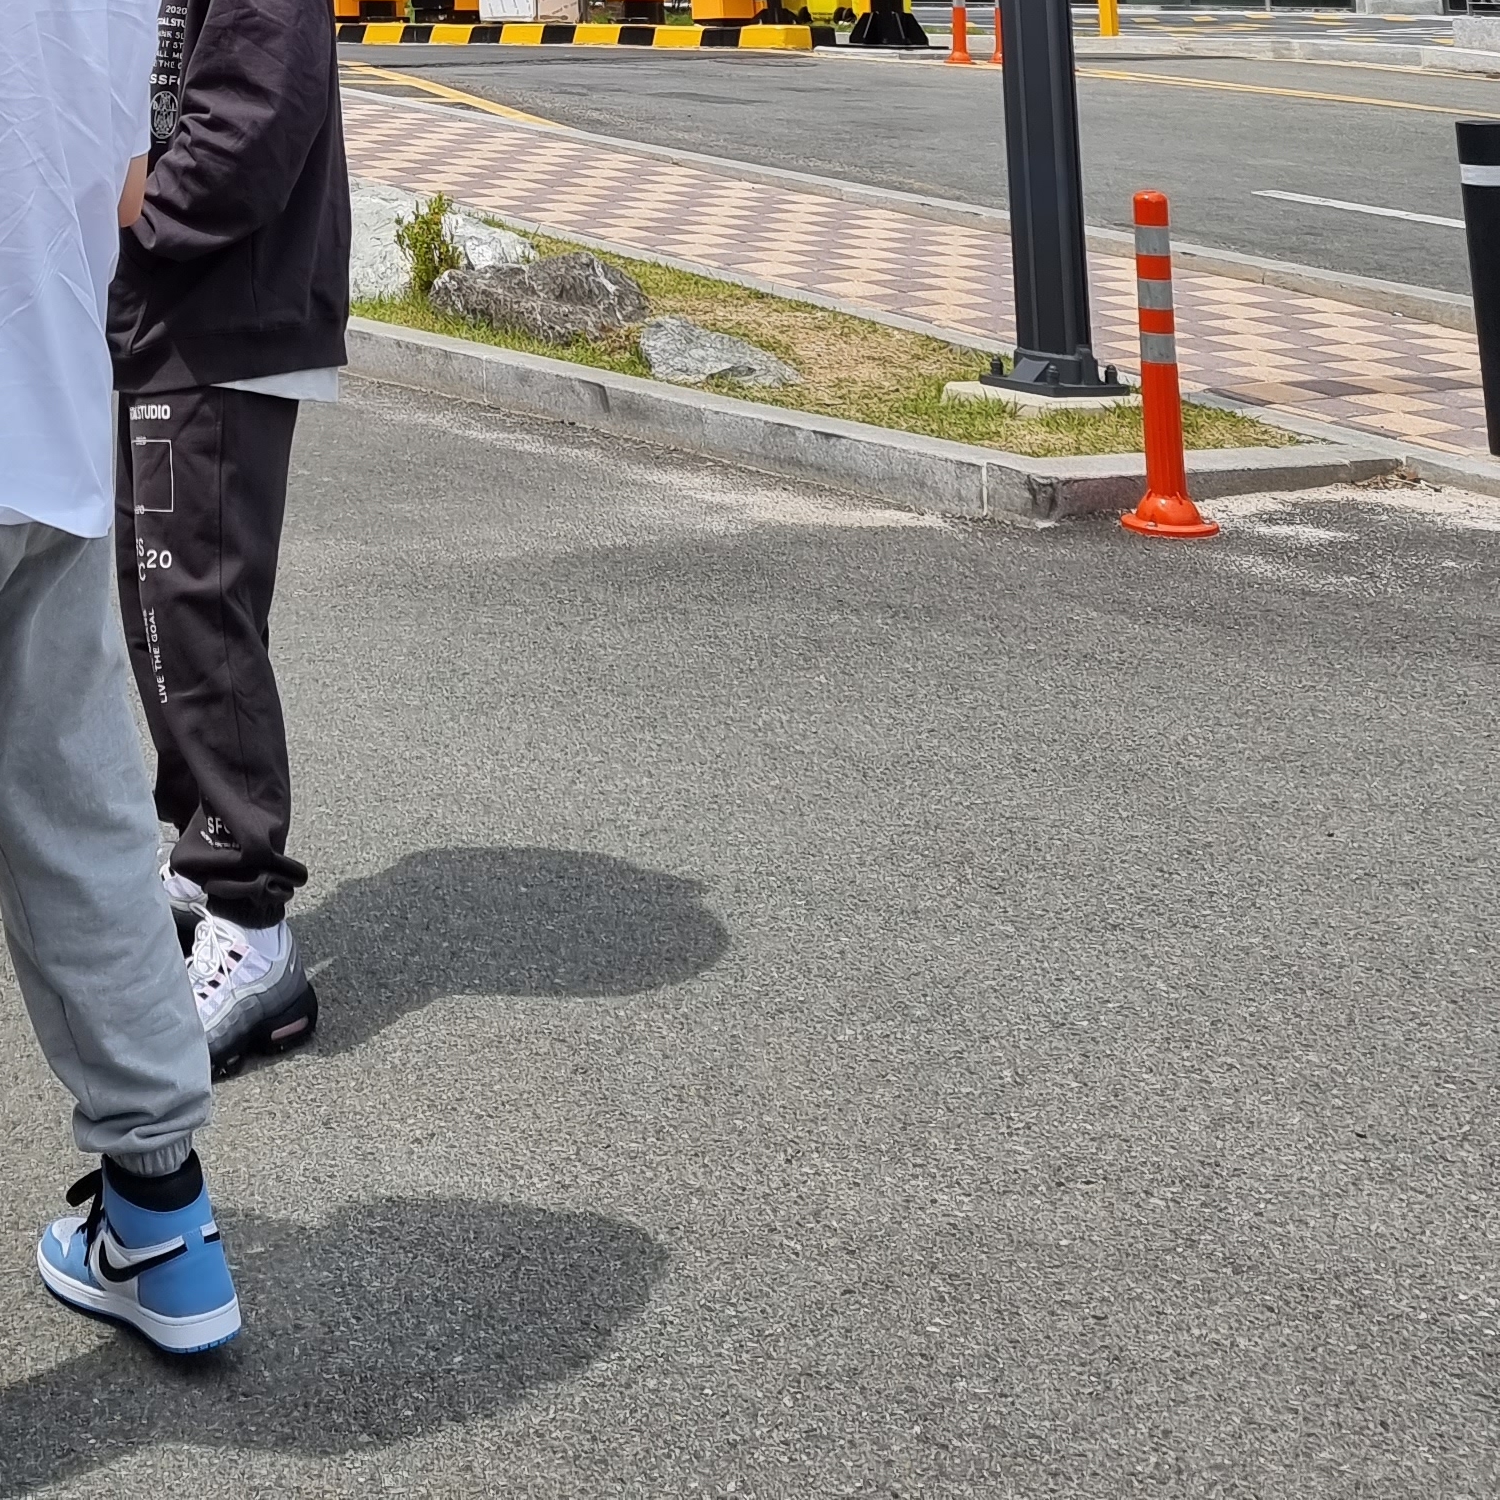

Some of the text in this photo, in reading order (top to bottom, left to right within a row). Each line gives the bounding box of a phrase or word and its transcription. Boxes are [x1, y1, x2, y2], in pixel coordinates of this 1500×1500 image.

[146, 550, 172, 568] 20
[148, 607, 158, 642] GOAL
[152, 646, 163, 672] THE
[156, 674, 168, 703] LIVE
